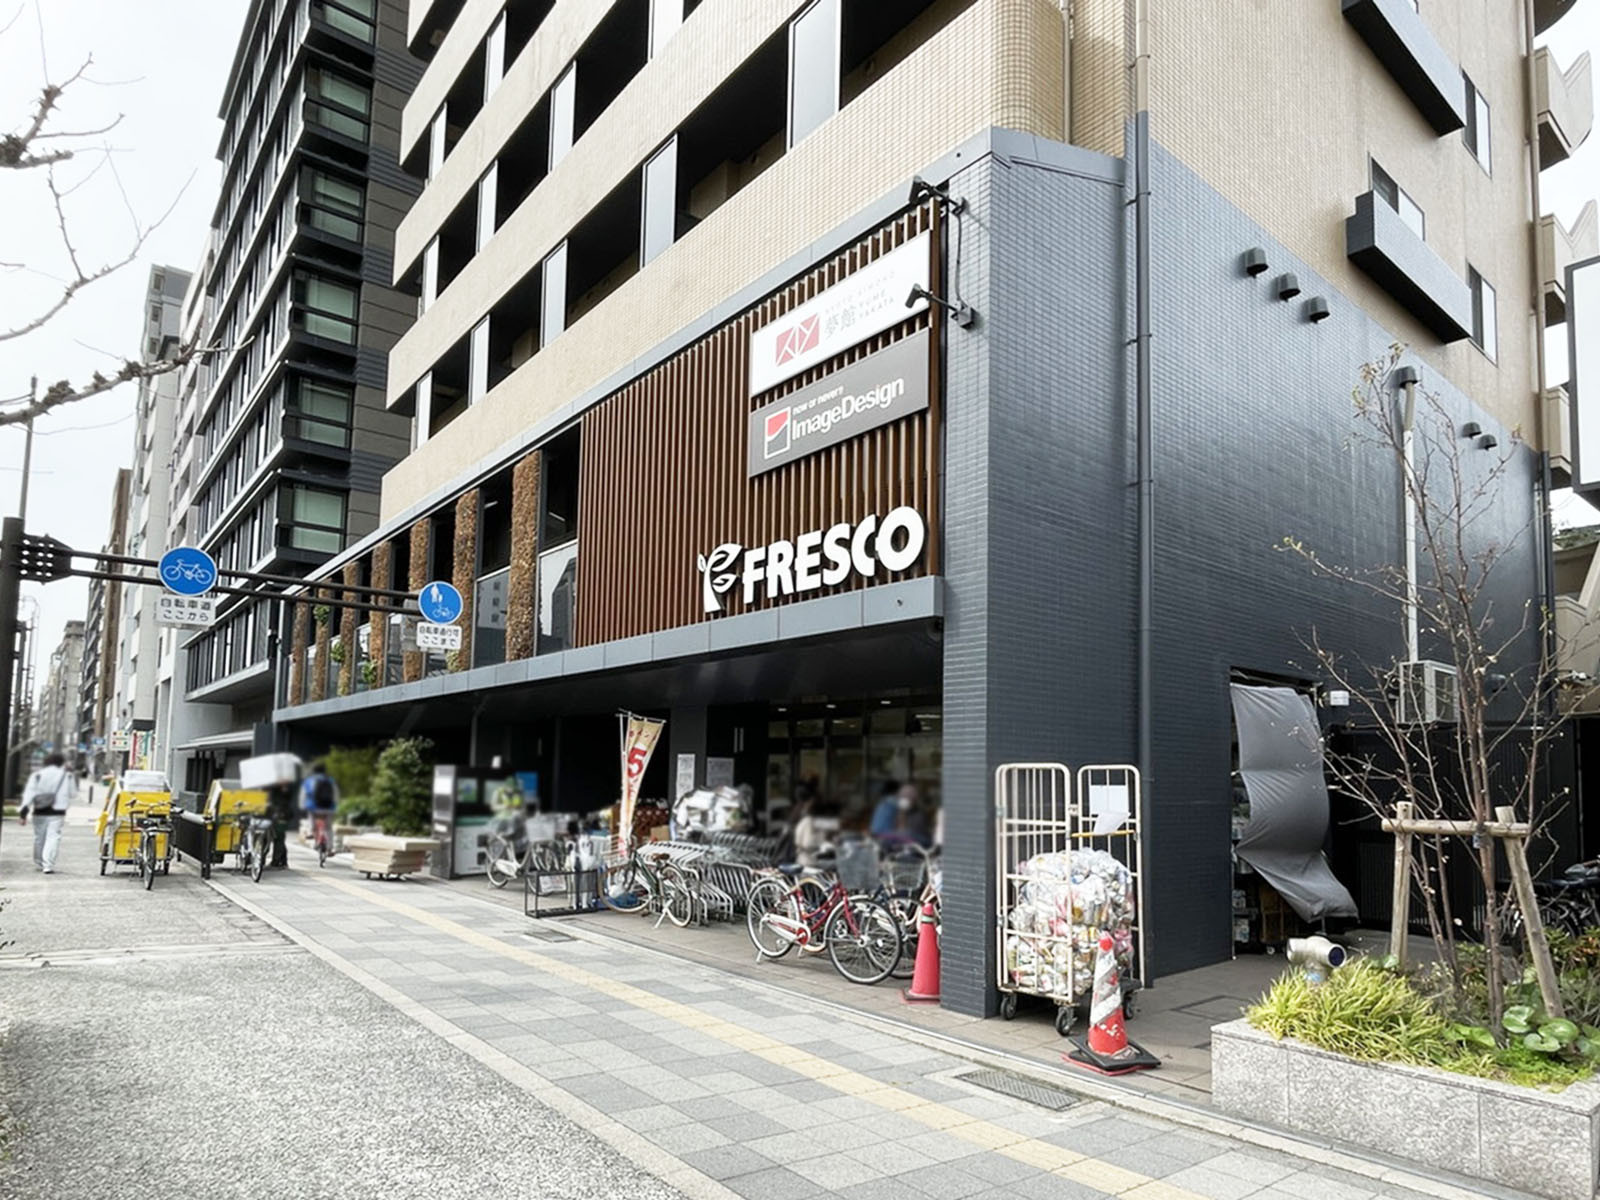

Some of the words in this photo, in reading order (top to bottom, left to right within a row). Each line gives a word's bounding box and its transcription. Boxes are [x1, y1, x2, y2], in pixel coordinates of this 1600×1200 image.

[792, 378, 905, 441] ImageDesign
[743, 506, 924, 604] FRESCO
[160, 598, 211, 611] 自転車道
[163, 609, 209, 622] ここから
